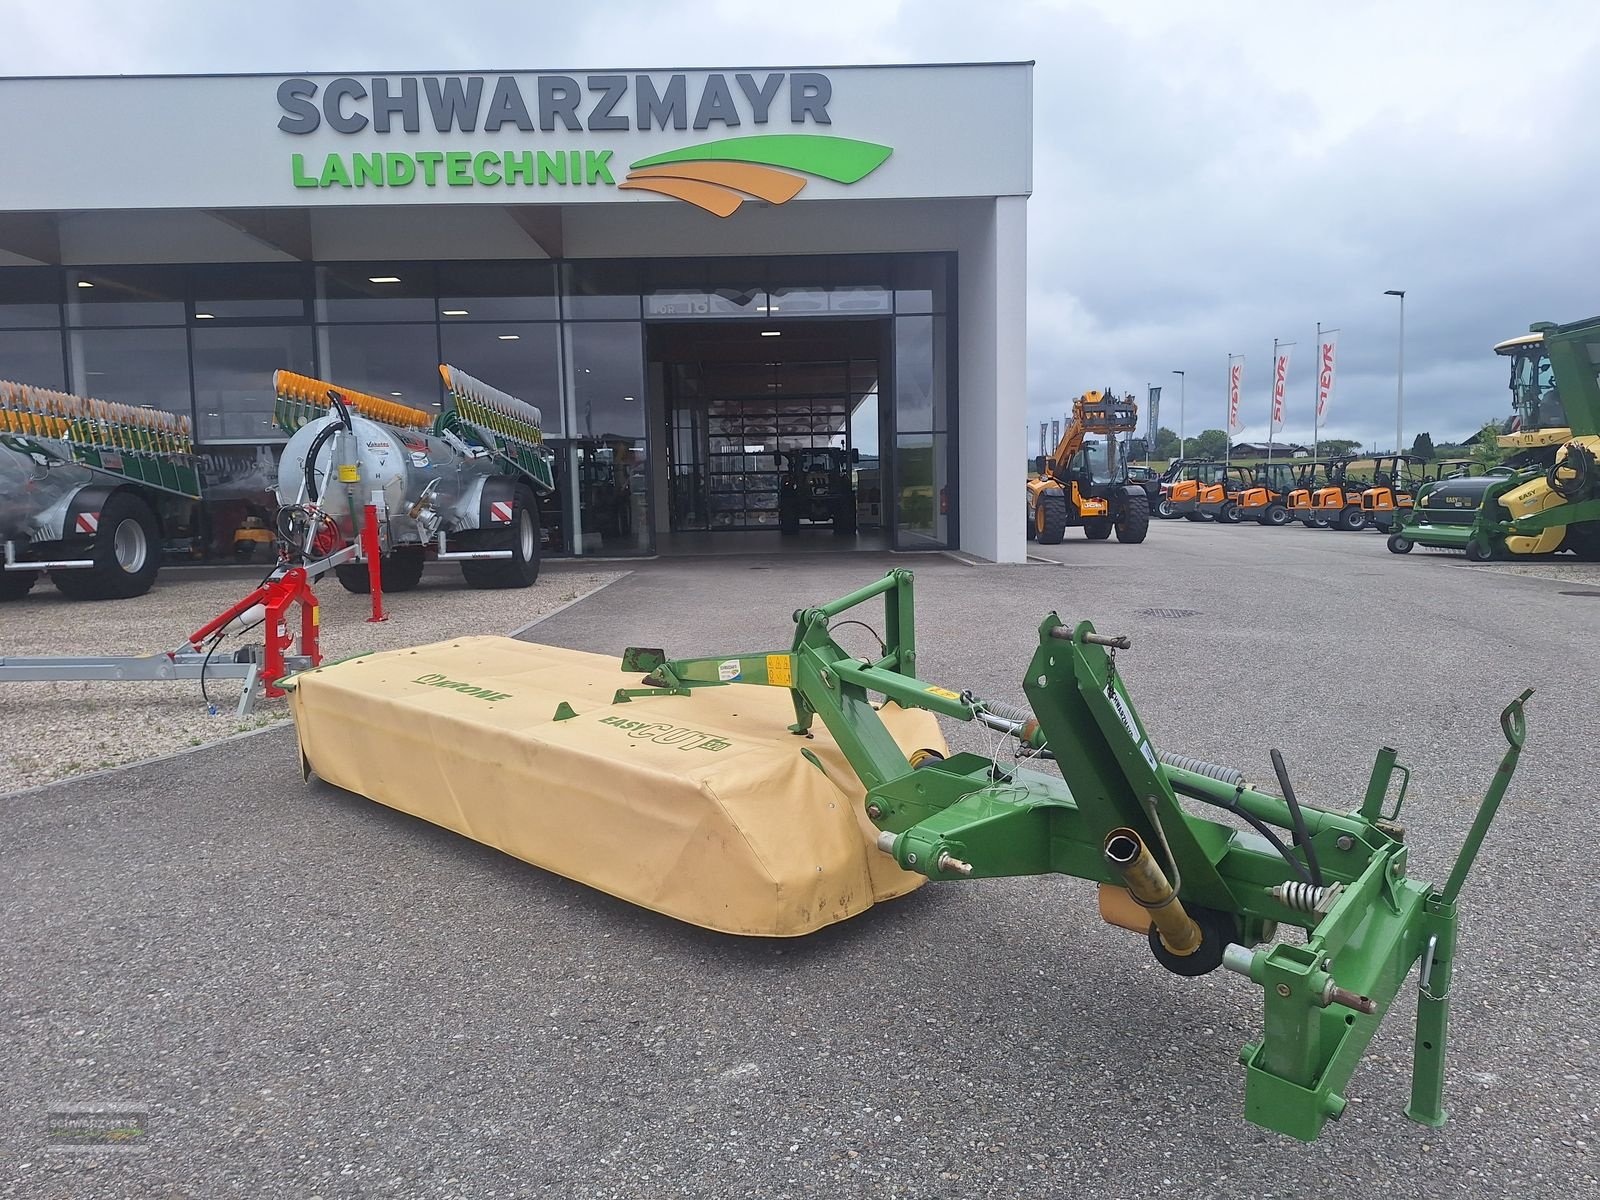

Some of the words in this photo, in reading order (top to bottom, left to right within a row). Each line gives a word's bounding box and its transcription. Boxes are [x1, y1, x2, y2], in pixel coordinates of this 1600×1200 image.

[277, 73, 832, 134] SCHWARZMAYR
[292, 151, 615, 187] LANDTECHNIK
[1274, 356, 1287, 423] STEYR
[1518, 489, 1537, 501] EASY
[427, 680, 513, 702] KRONE
